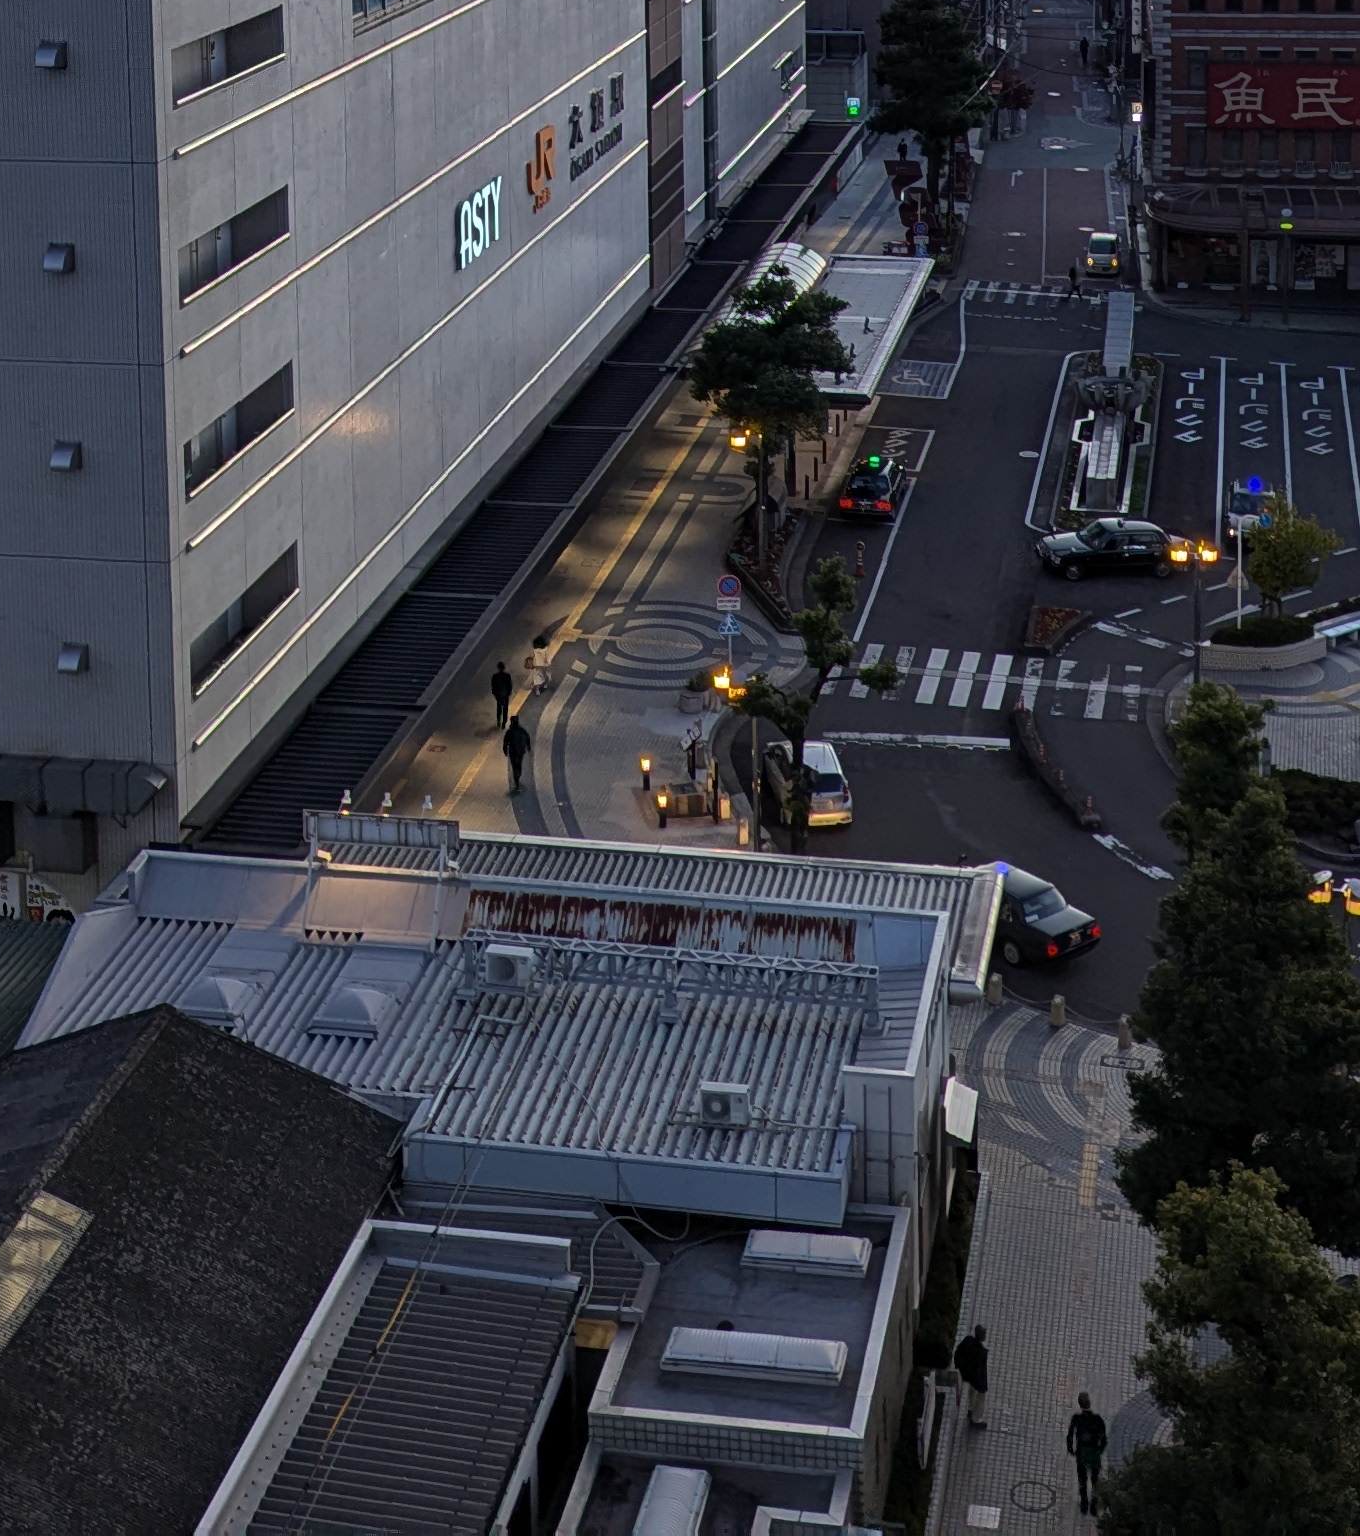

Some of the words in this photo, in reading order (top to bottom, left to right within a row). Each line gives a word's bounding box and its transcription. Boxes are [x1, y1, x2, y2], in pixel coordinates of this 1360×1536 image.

[1213, 71, 1355, 126] 魚民
[526, 125, 556, 195] JR
[459, 175, 503, 270] ASTY
